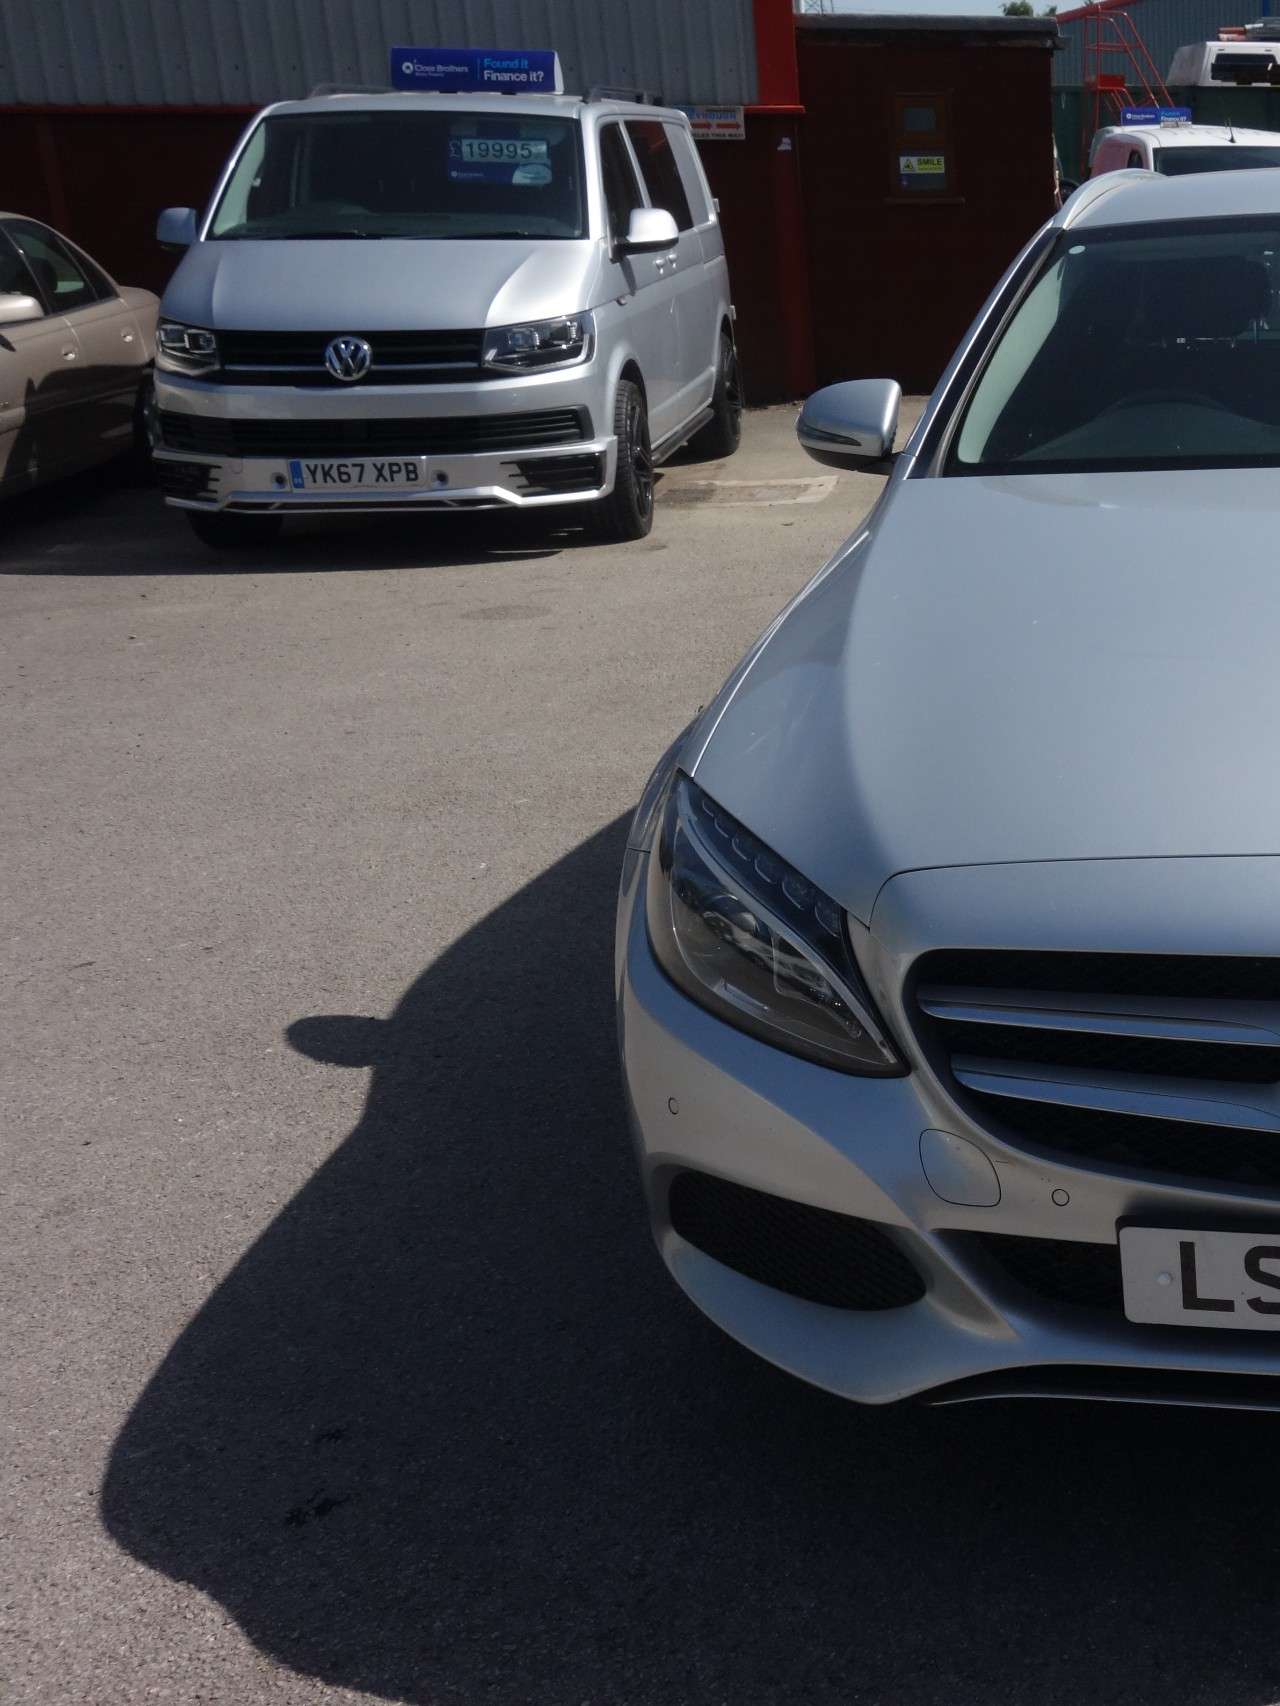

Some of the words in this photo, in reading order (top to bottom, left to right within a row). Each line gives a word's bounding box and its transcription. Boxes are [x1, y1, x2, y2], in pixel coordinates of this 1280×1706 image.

[437, 65, 469, 73] Brothers
[483, 58, 519, 69] Found
[520, 58, 529, 69] it
[483, 70, 528, 82] Finance
[529, 71, 545, 82] it?
[465, 142, 533, 159] 19995
[305, 463, 365, 484] YK67
[372, 462, 419, 482] XPB
